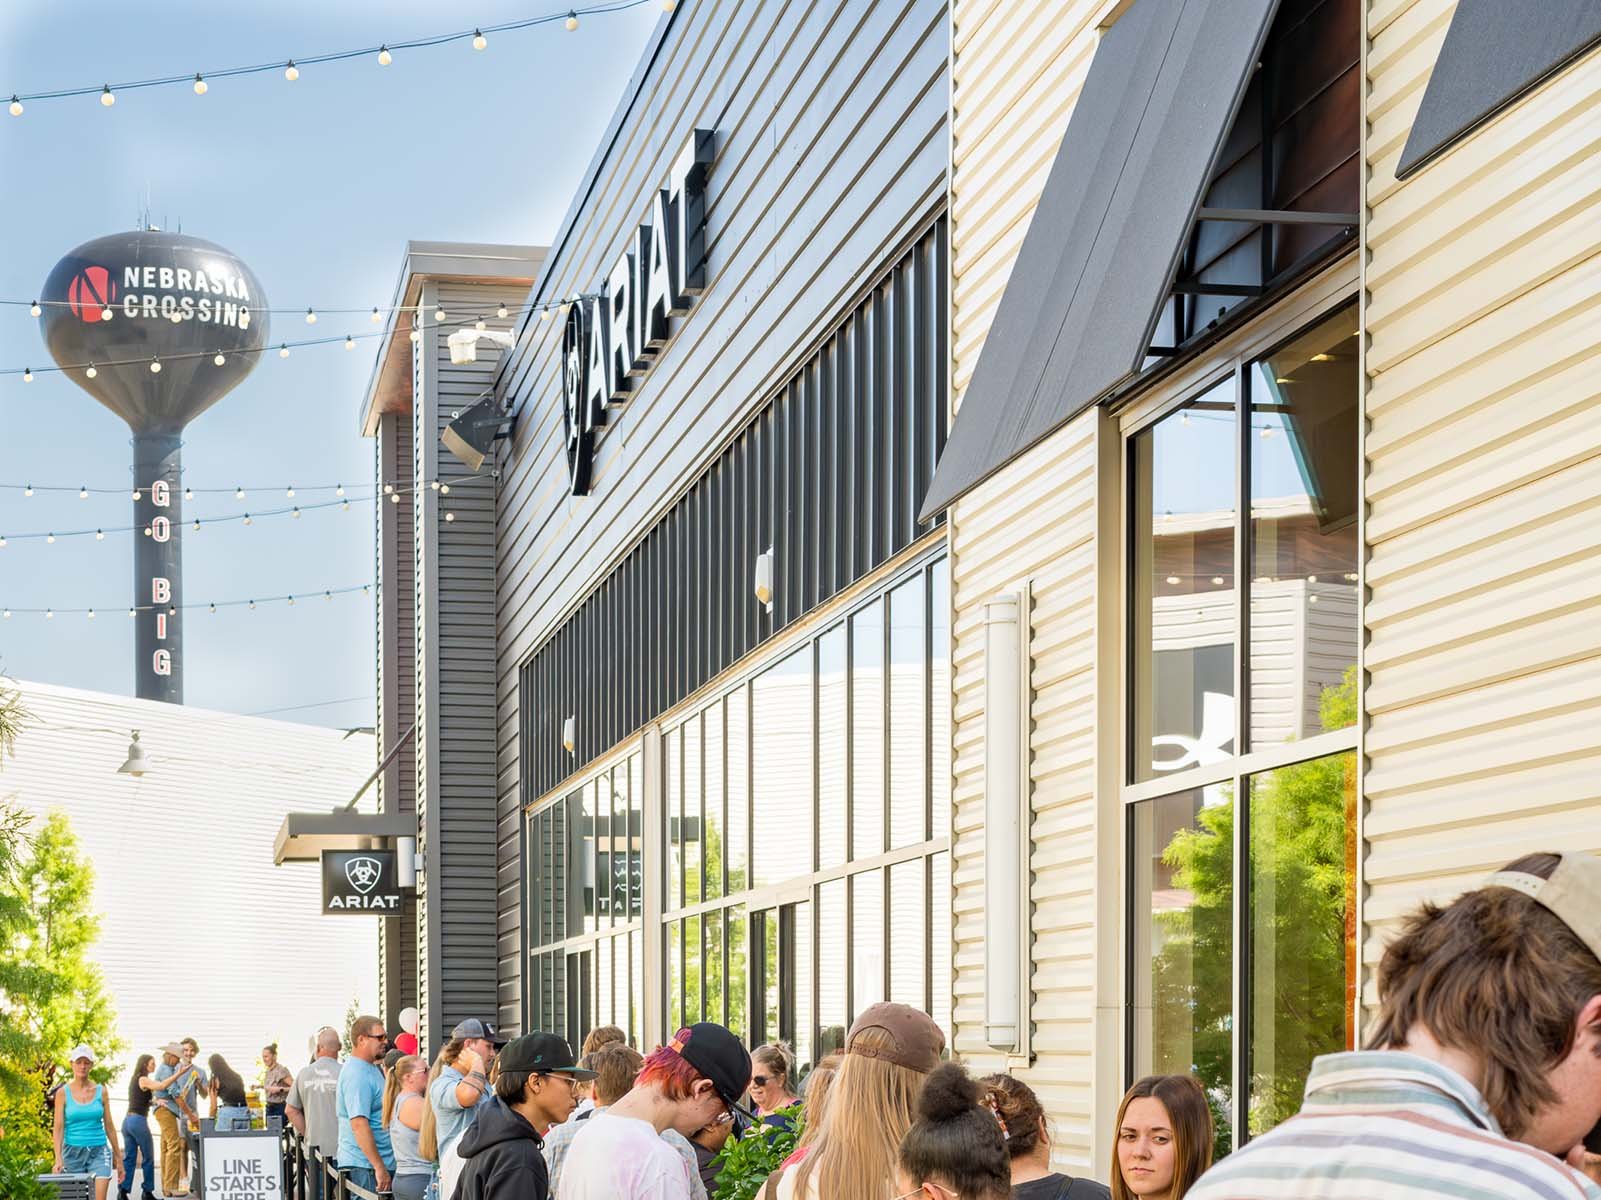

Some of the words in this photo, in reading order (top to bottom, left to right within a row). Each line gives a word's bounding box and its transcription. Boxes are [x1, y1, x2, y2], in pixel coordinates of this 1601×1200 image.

[124, 266, 249, 301] NEBRASKA
[585, 128, 712, 432] ARIAT
[152, 480, 170, 542] GO
[152, 578, 171, 675] BIG
[328, 895, 399, 909] ARIAT
[210, 1175, 276, 1191] STARTS
[223, 1159, 262, 1175] LINE
